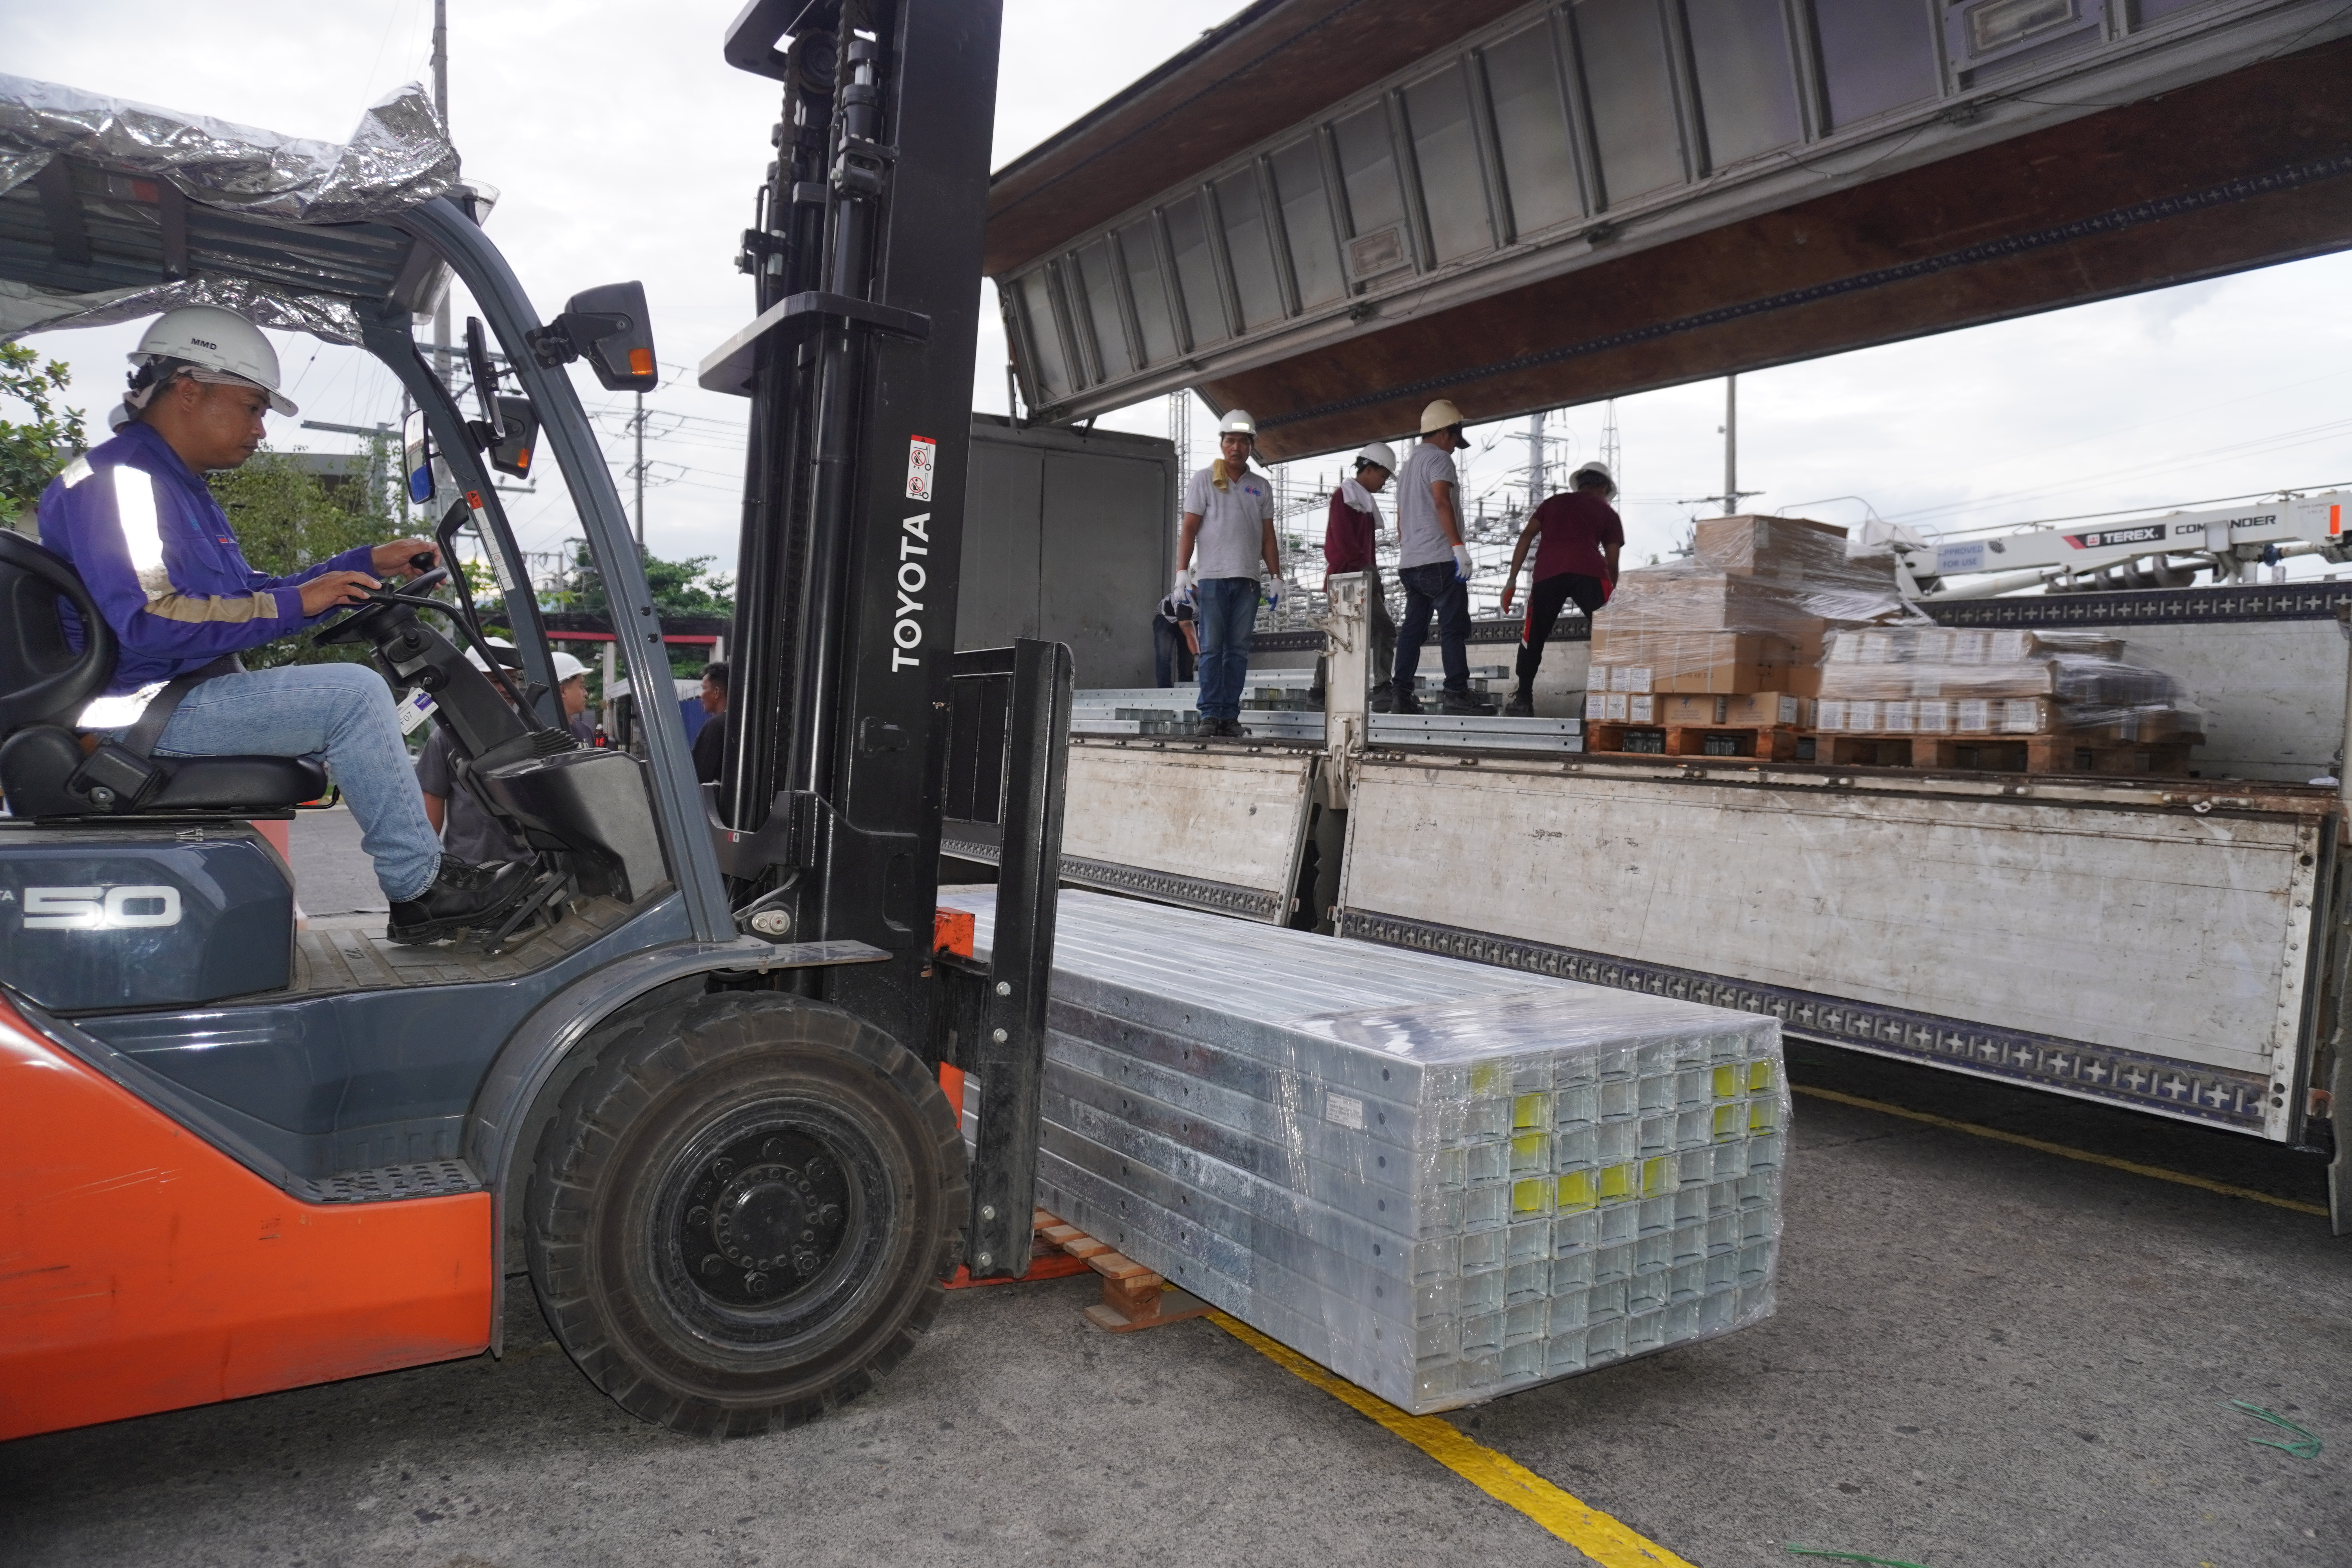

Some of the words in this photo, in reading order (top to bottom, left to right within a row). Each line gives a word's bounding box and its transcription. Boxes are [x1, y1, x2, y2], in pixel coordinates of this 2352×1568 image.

[191, 338, 217, 350] MMD
[2103, 528, 2155, 544] TEREX
[1943, 560, 1960, 568] FOR
[1962, 558, 1977, 566] USE
[891, 512, 931, 673] TOYOTA
[400, 711, 412, 726] F07
[24, 886, 181, 929] 50
